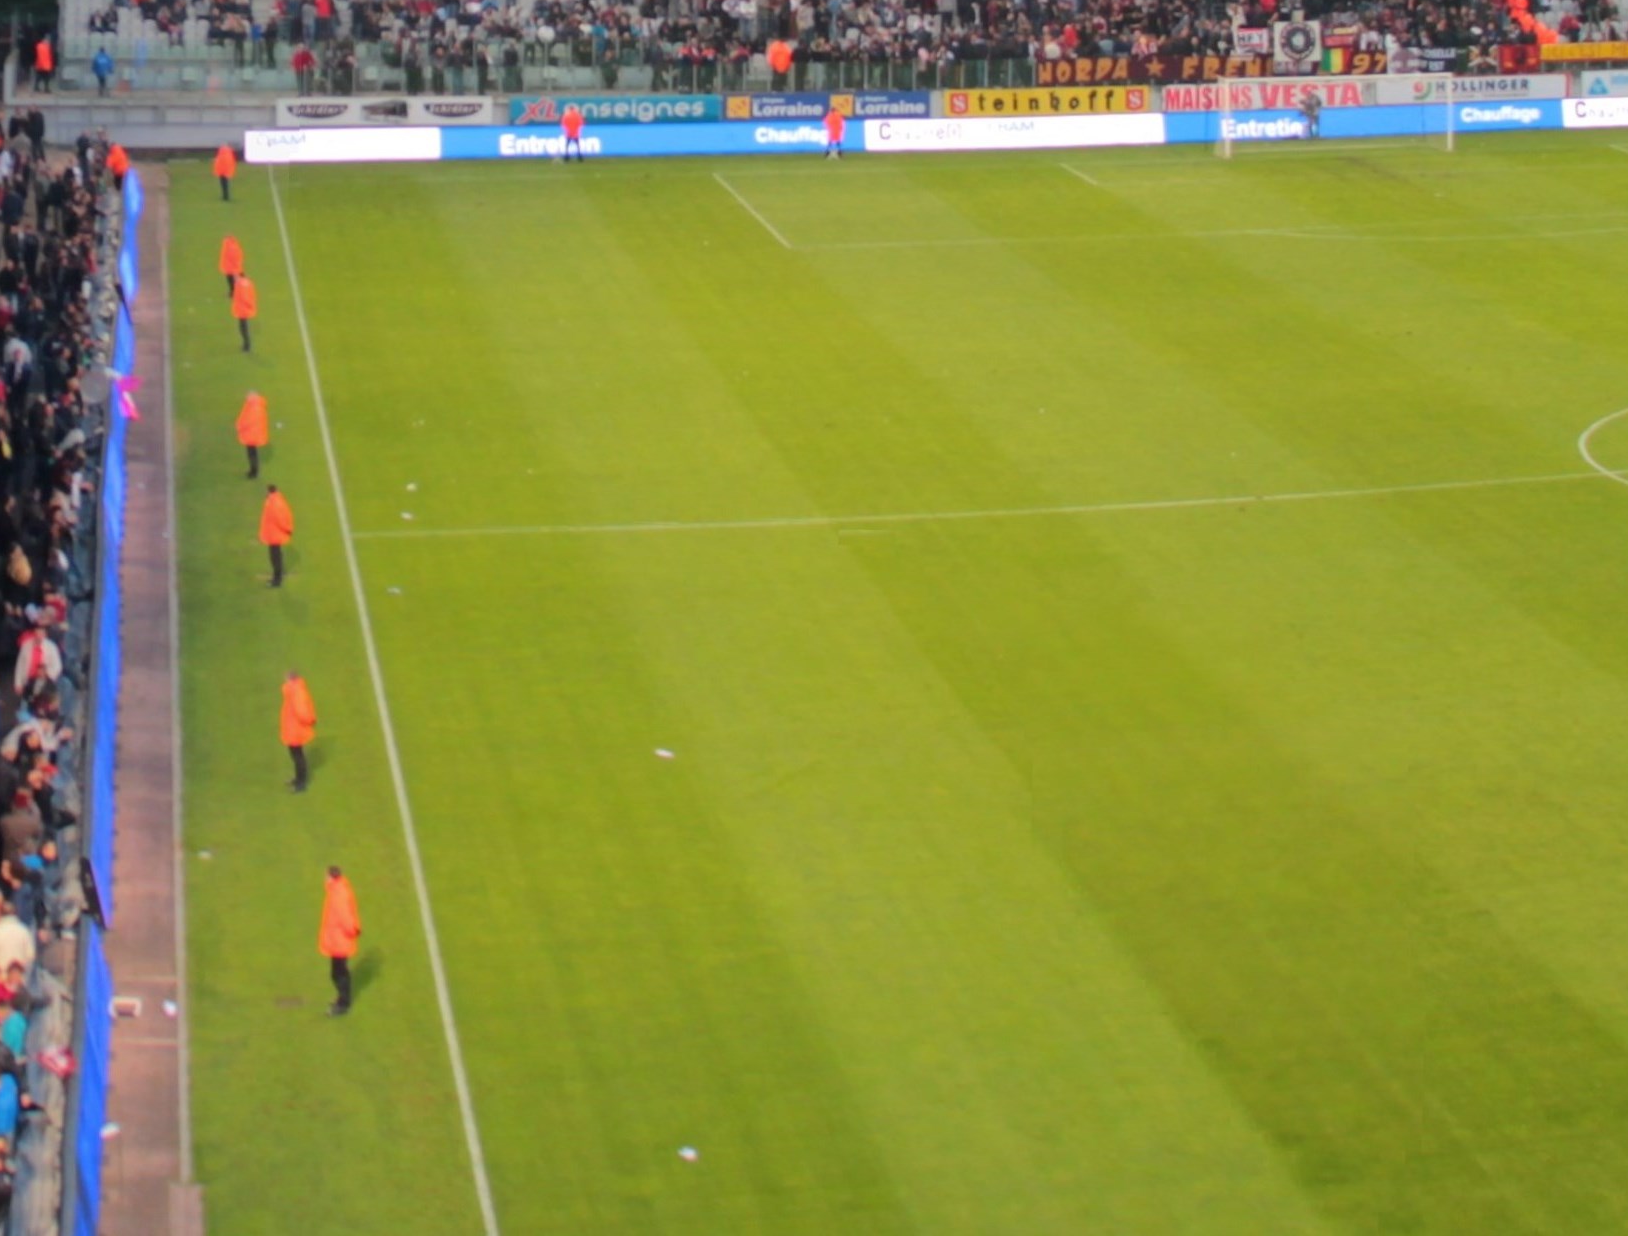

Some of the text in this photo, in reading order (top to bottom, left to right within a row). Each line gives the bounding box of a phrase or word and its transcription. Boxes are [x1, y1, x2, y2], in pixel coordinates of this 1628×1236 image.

[1352, 53, 1387, 74] 97
[1258, 81, 1362, 107] VESTA
[1436, 79, 1529, 92] HOLLINGER
[752, 102, 823, 116] Lorraine
[855, 100, 926, 115] Lorraine
[1461, 106, 1540, 124] Chauffage
[754, 126, 828, 145] Chauffag
[1221, 119, 1305, 139] Entretie
[499, 133, 601, 156] Entreten
